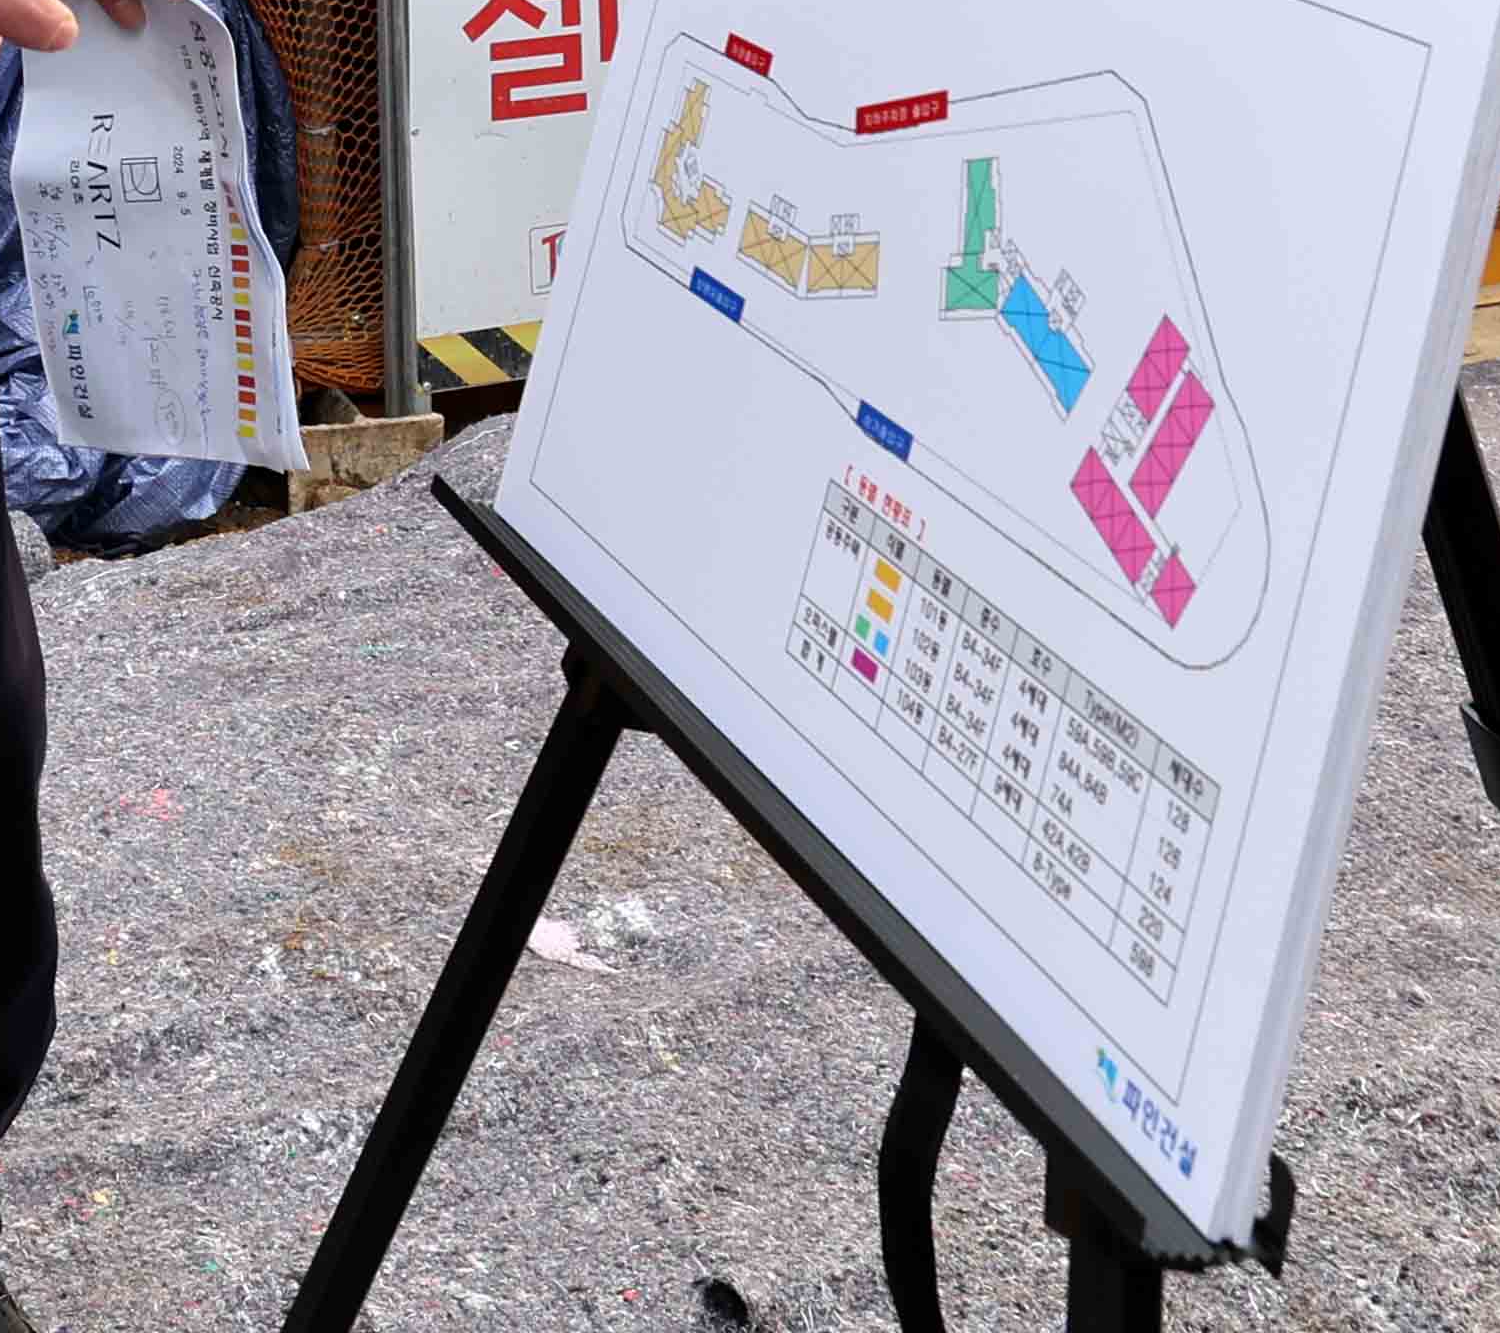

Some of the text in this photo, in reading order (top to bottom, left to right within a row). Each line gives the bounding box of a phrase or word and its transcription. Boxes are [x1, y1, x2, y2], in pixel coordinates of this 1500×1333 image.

[202, 199, 228, 255] 정비사업
[206, 264, 225, 322] 신축공사
[68, 344, 95, 421] 파인건설
[1122, 1078, 1197, 1179] 파인건설
